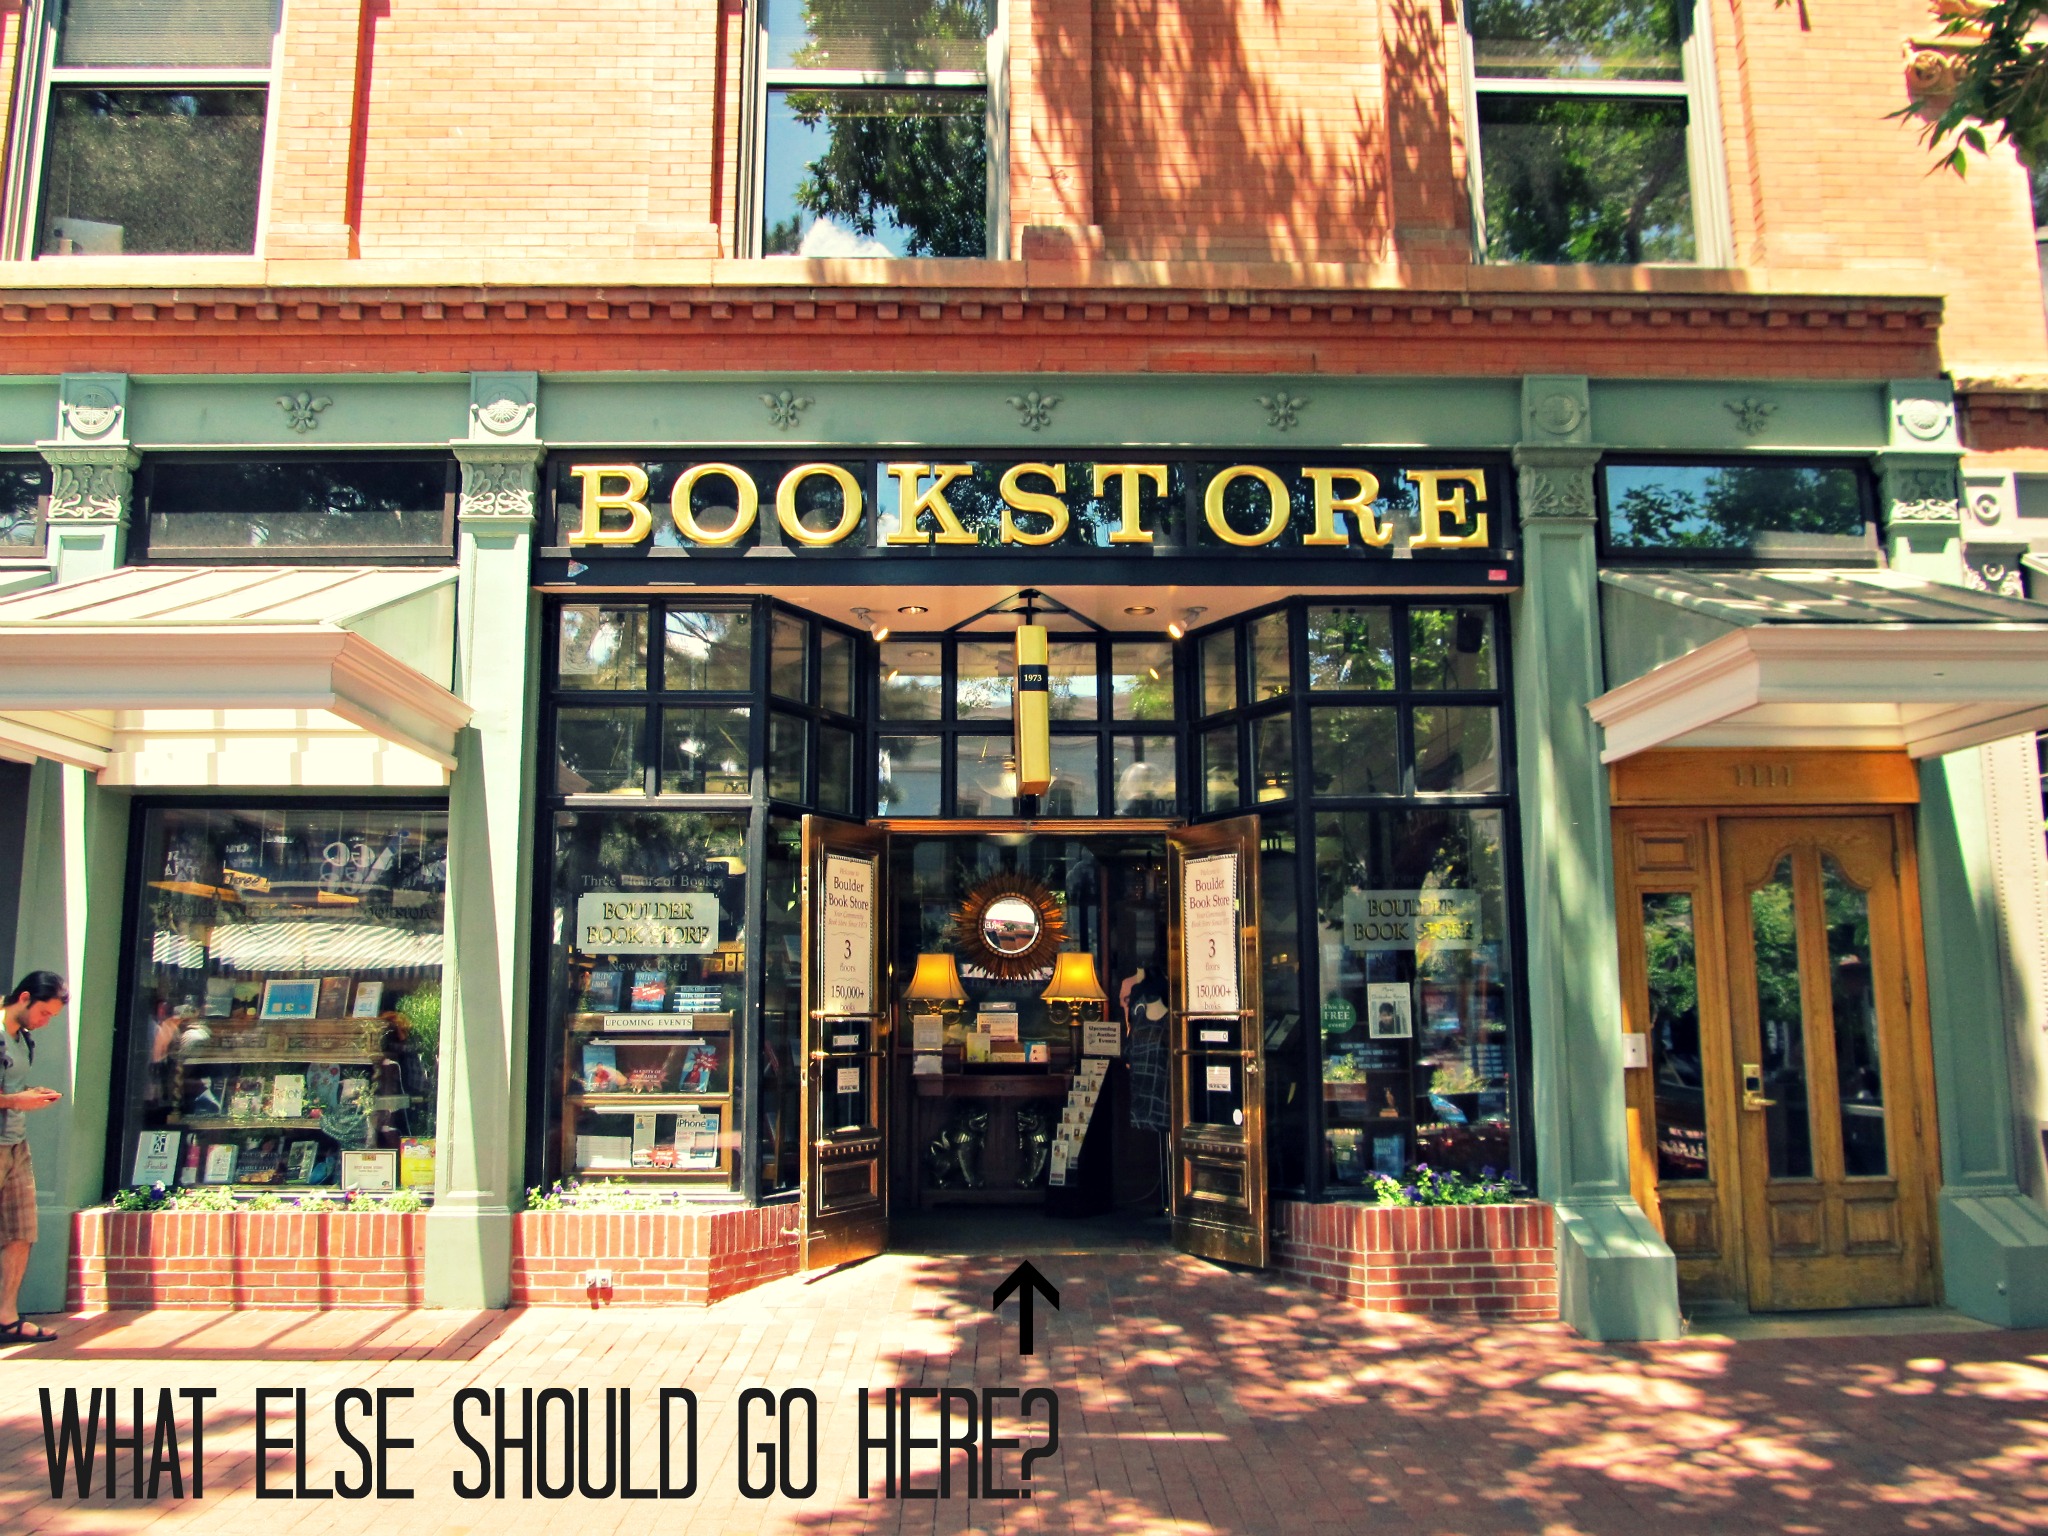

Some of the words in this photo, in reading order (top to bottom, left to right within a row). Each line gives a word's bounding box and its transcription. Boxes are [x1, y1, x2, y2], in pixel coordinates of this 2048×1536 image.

[567, 462, 1490, 549] BOOKSTORE
[1023, 674, 1042, 682] 1973
[1733, 764, 1792, 788] 1111
[582, 874, 617, 887] Three
[663, 874, 678, 887] of
[833, 876, 865, 893] Boulder
[1195, 877, 1225, 892] Boulder
[828, 892, 849, 908] Book
[849, 895, 869, 911] Store
[1189, 895, 1211, 909] Book
[1212, 894, 1230, 908] Store
[1367, 899, 1457, 917] BOULDER
[603, 902, 694, 920] BOULDER
[586, 926, 644, 944] BOOK
[1353, 923, 1411, 942] BOOK
[843, 939, 852, 959] 3
[1208, 938, 1216, 958] 3
[608, 960, 637, 972] New
[640, 960, 653, 972] &
[657, 960, 689, 972] Used
[840, 962, 856, 973] floors
[831, 985, 865, 1000] 150,000+
[1196, 984, 1232, 999] 150,000+
[605, 1018, 655, 1027] UPCOMING
[658, 1018, 692, 1027] EVENTS
[1324, 1011, 1351, 1020] FREE
[676, 1118, 706, 1129] iPhone
